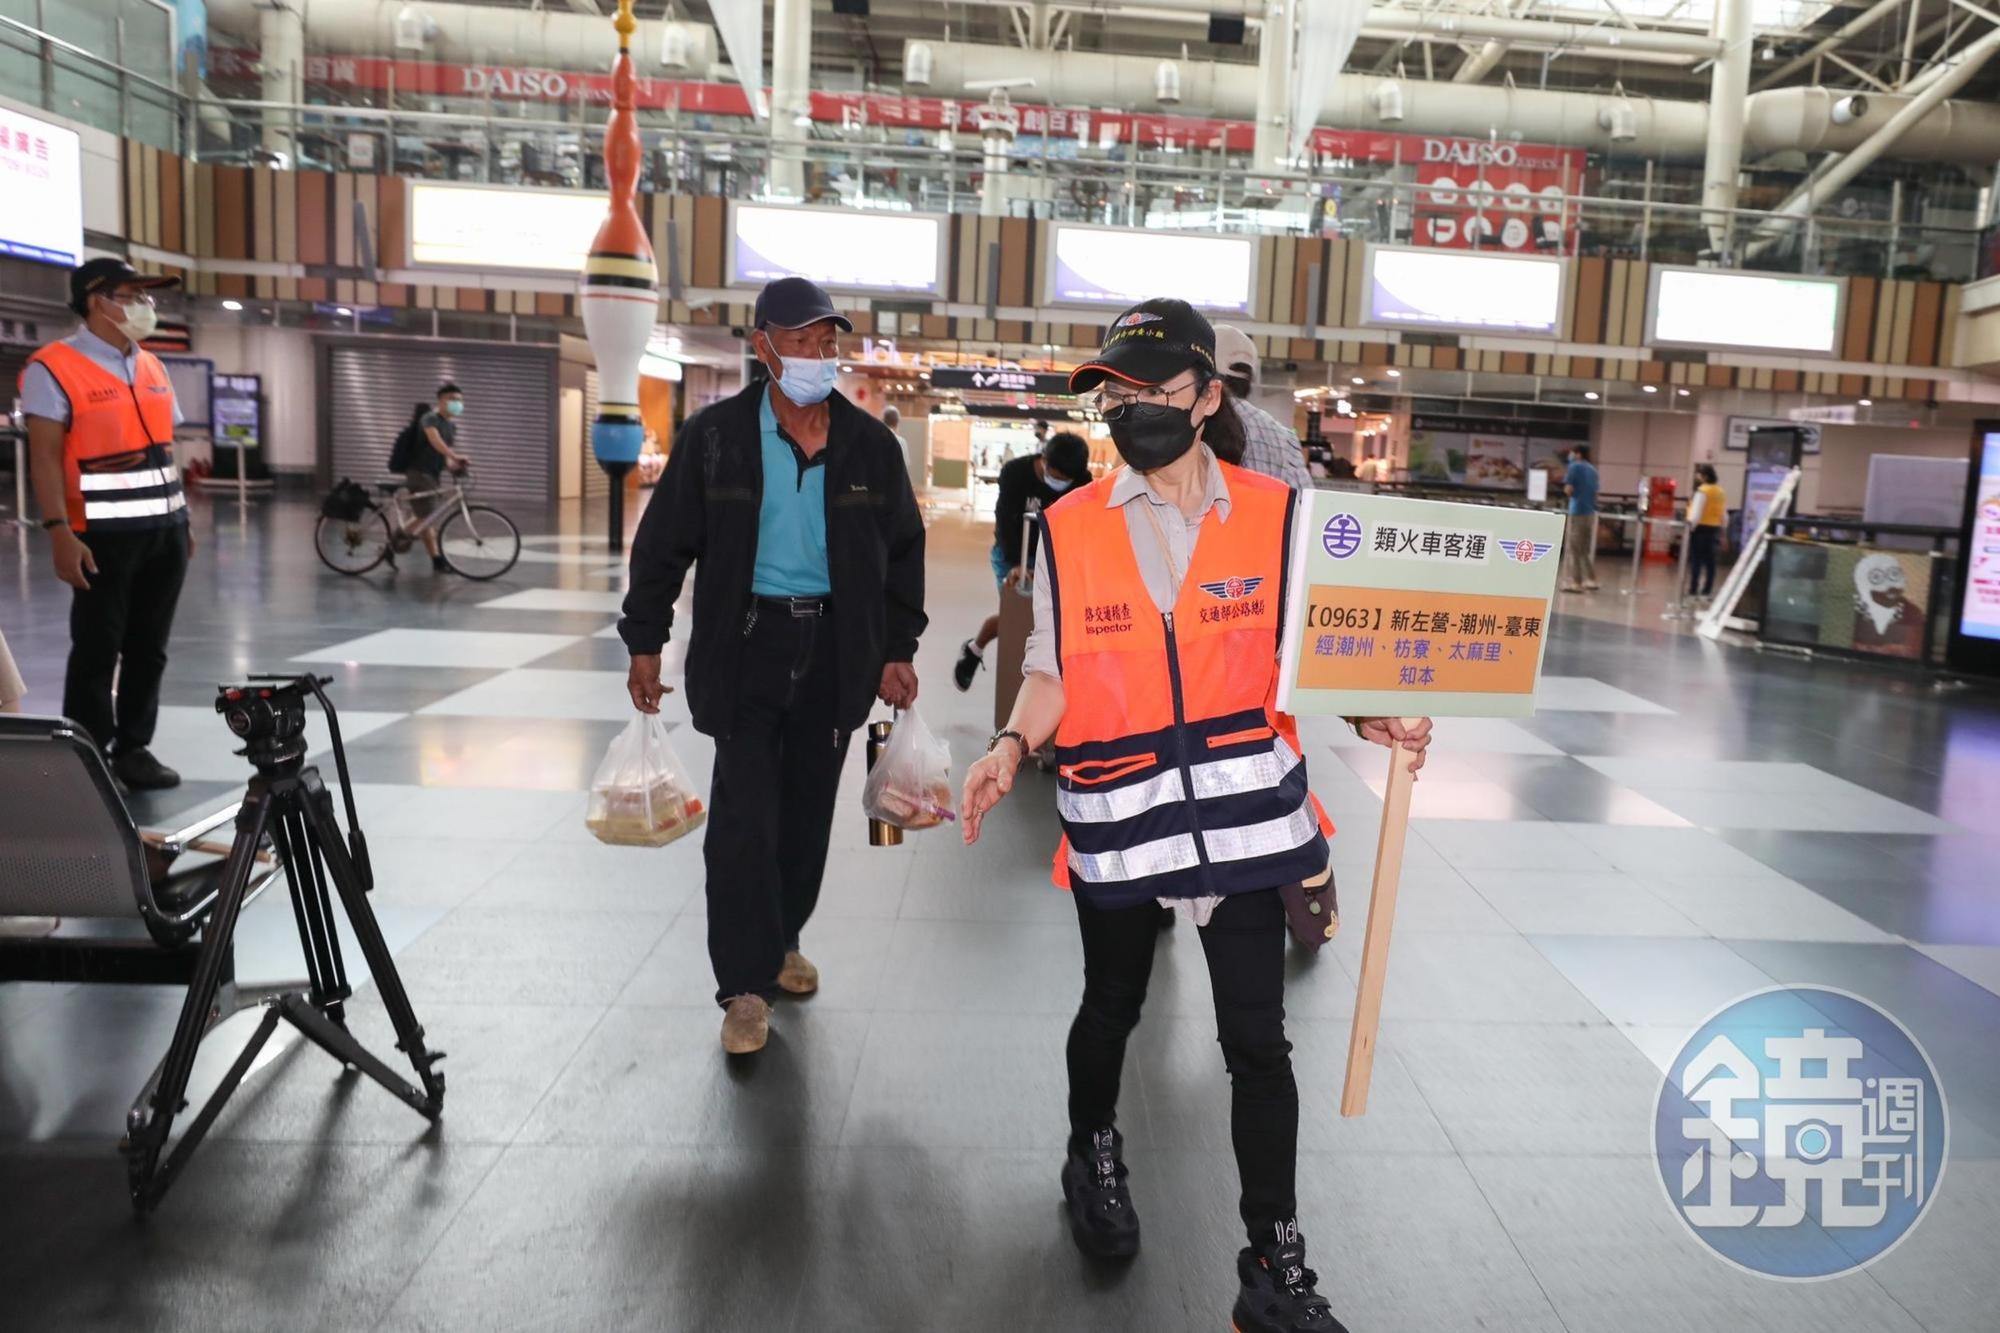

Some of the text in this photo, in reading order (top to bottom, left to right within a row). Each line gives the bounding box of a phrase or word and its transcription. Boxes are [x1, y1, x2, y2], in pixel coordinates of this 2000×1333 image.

[462, 67, 568, 97] DAISO
[1424, 139, 1517, 166] DAISO
[1374, 526, 1488, 560] 類火車客運
[1398, 665, 1436, 686] 知本
